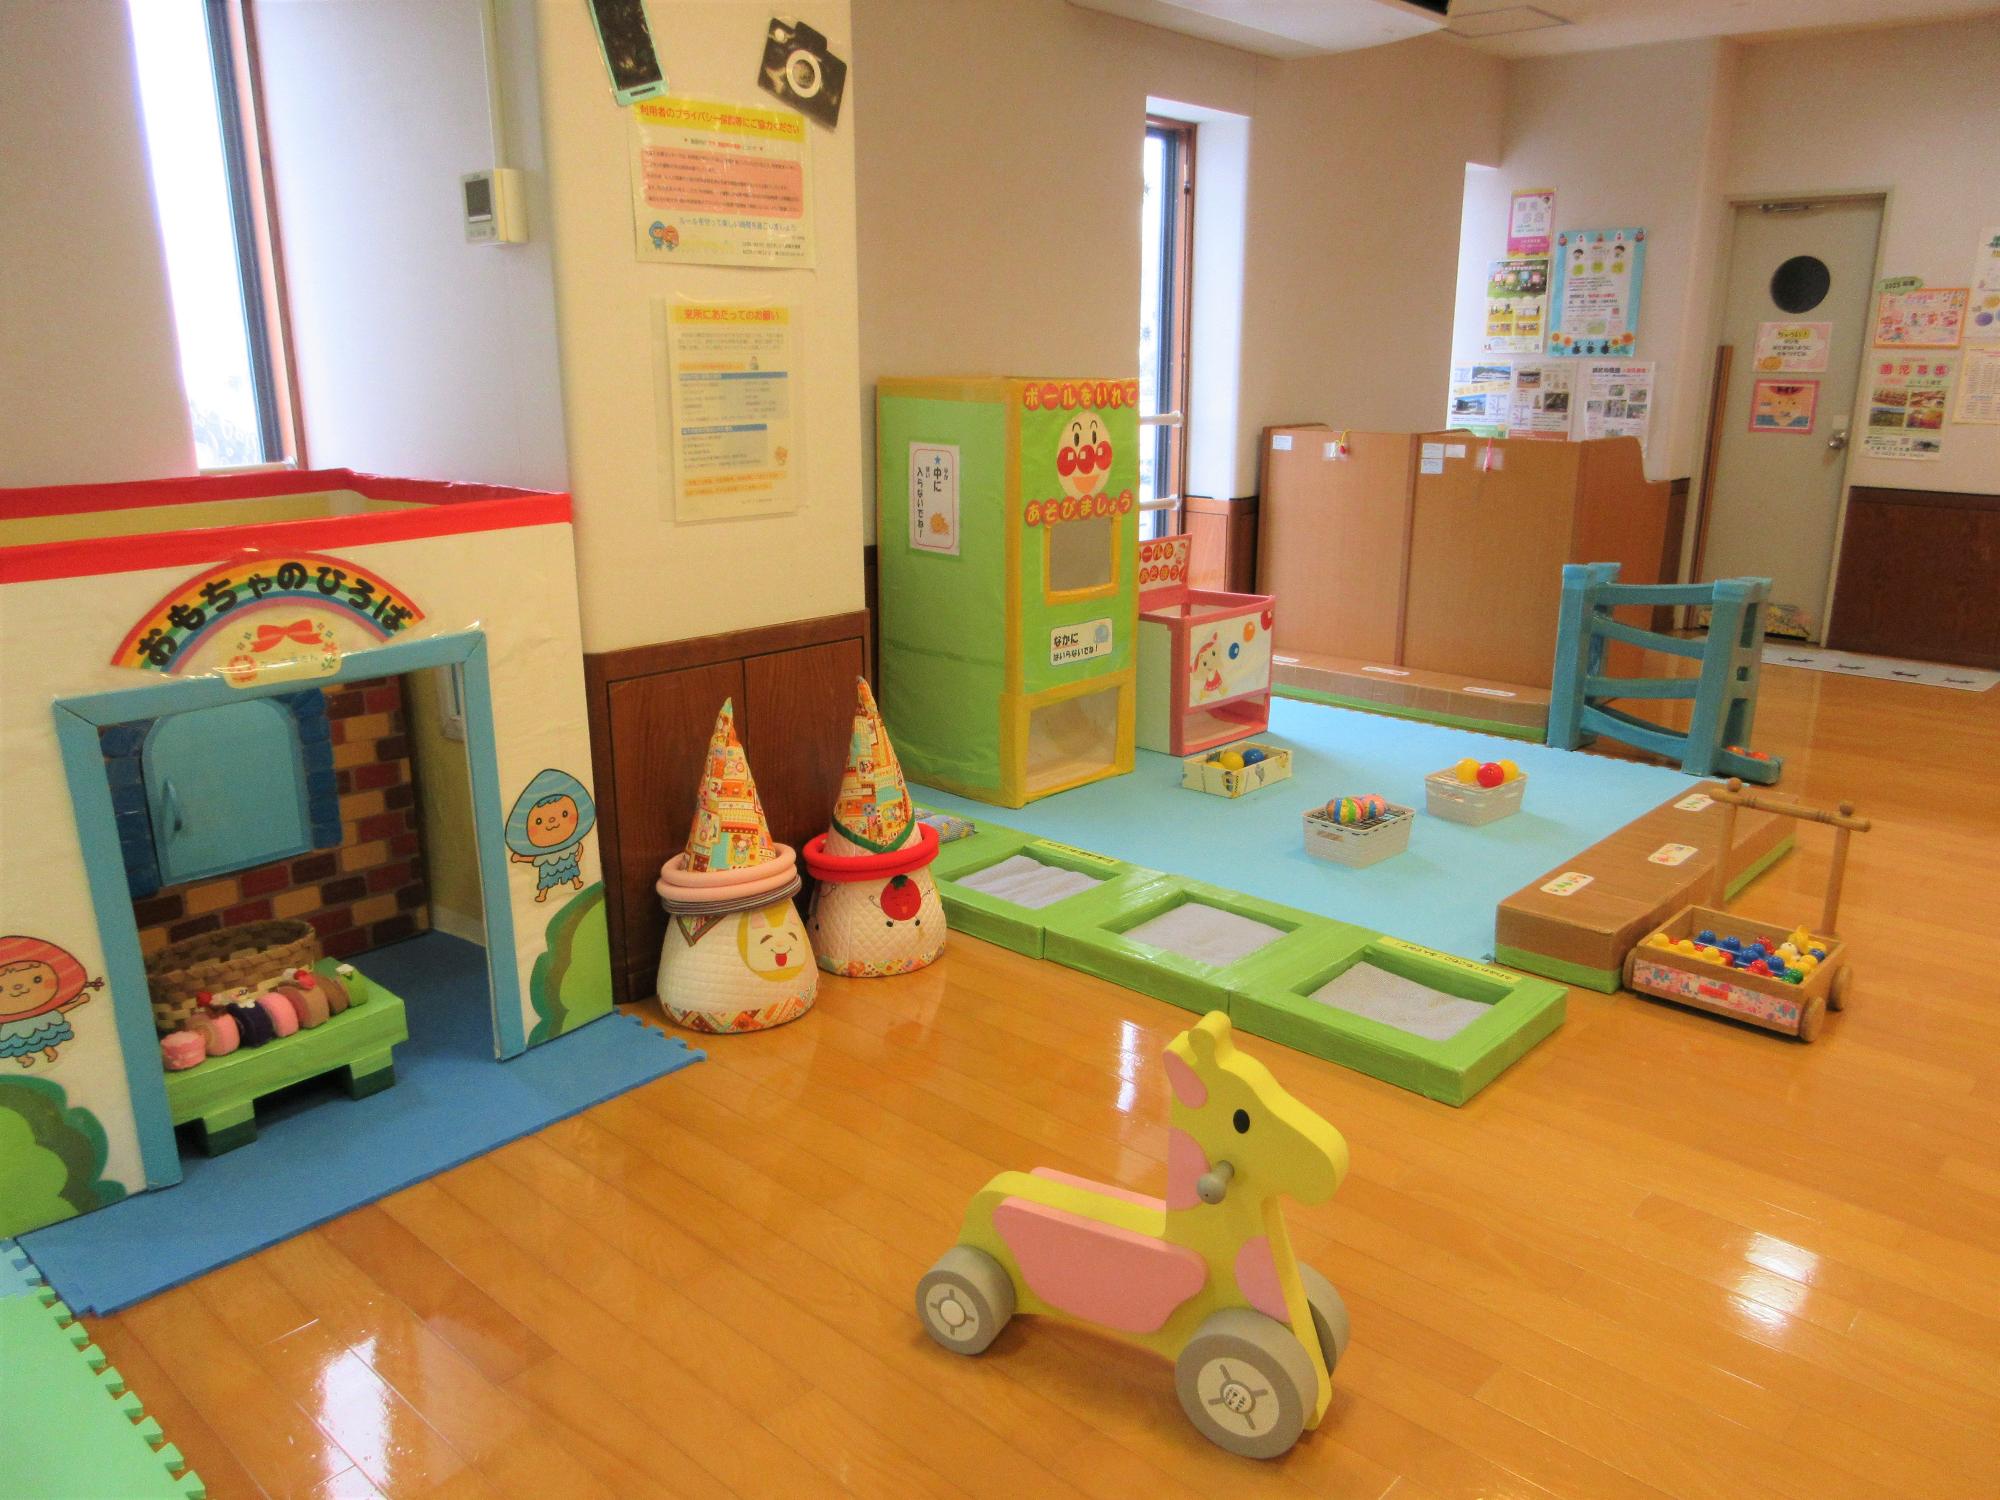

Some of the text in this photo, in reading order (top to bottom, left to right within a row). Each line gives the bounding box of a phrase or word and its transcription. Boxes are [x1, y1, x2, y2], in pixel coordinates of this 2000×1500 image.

[1025, 385, 1137, 407] ボールをいれて
[933, 466, 942, 492] 中に
[1027, 494, 1132, 522] あそびましょう
[137, 562, 412, 666] おもちゃのひろば
[1053, 632, 1079, 648] なかに
